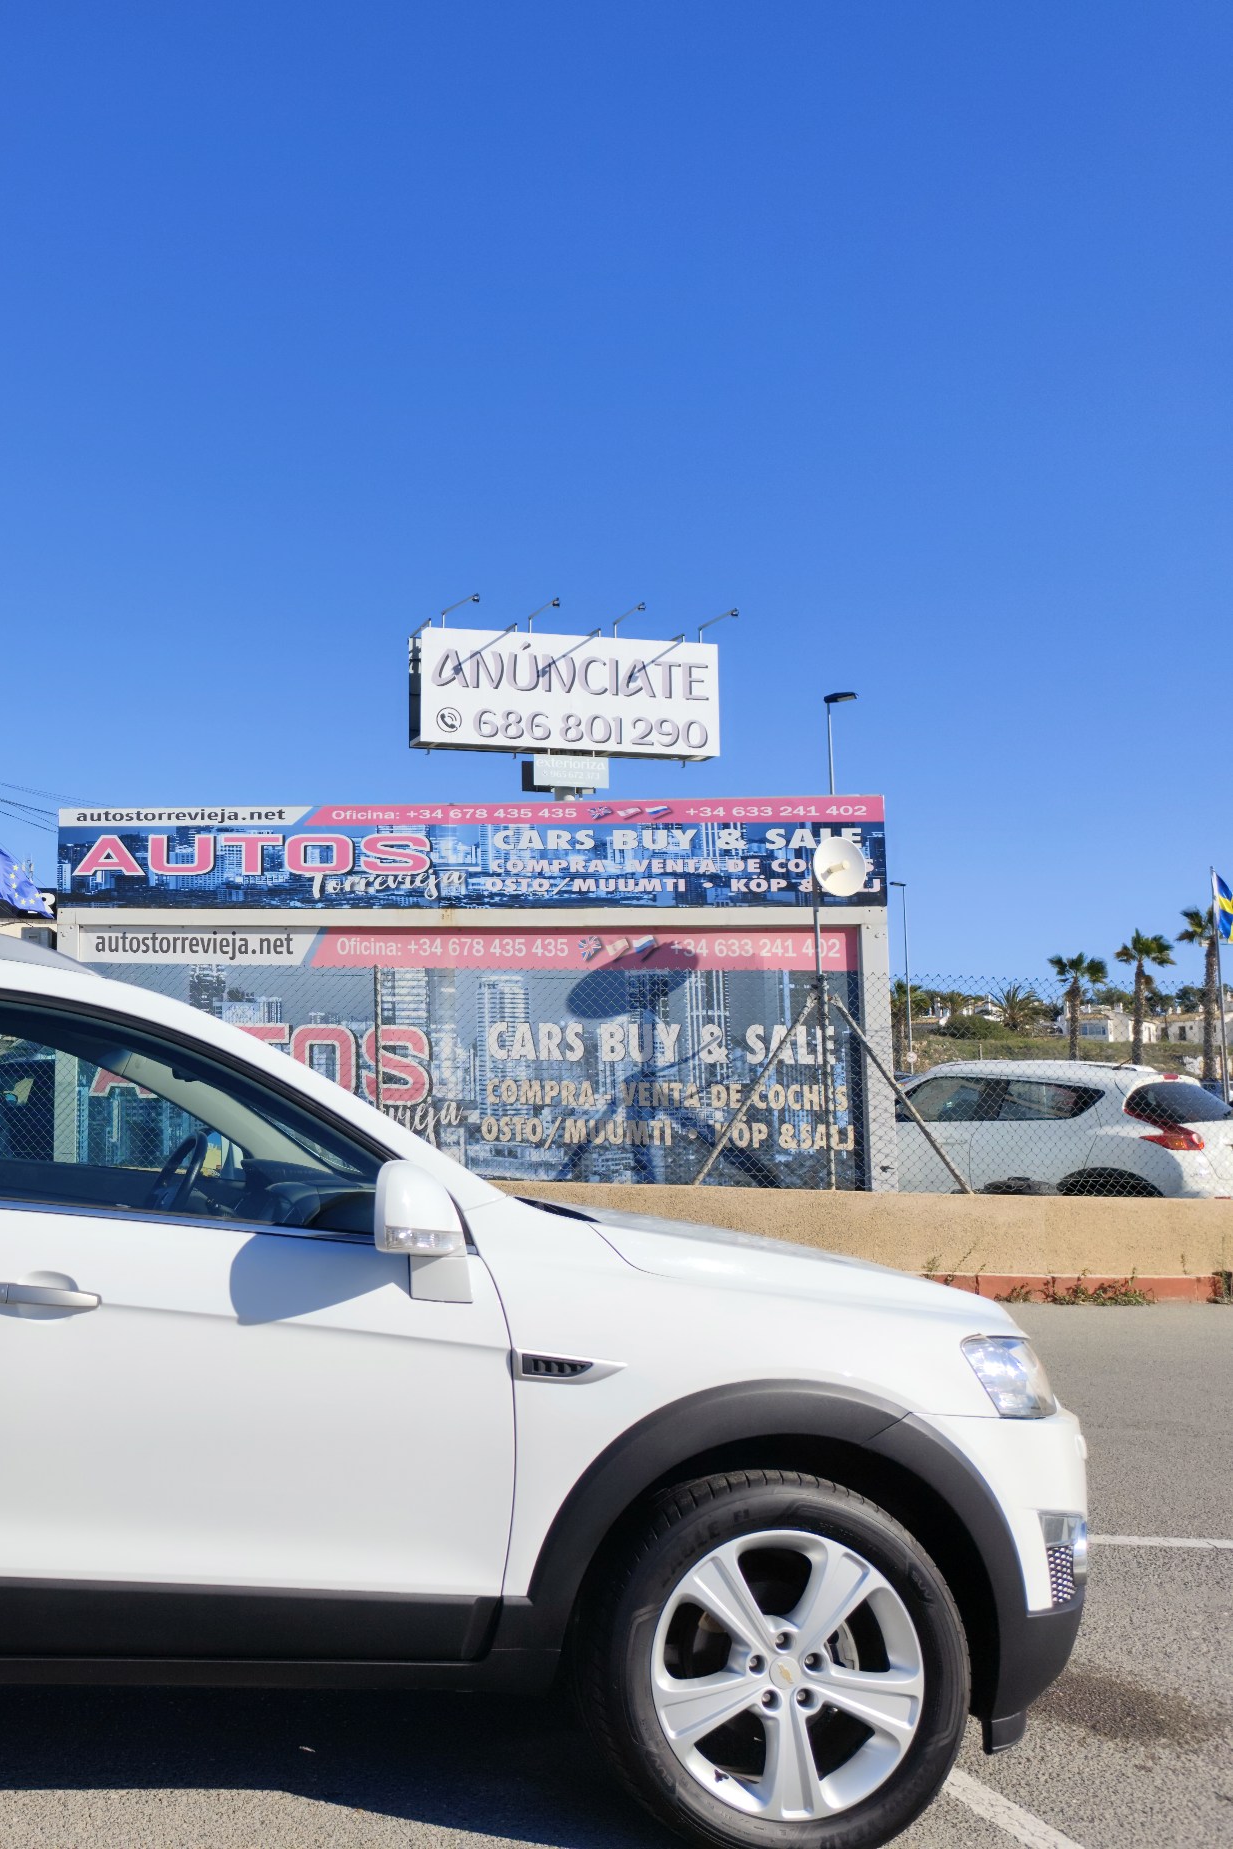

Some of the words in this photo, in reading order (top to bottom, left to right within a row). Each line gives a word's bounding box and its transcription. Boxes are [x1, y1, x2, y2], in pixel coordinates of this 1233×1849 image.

[431, 641, 709, 700] ANÚNCIATE
[473, 709, 551, 741] 686
[76, 808, 286, 823] autostorrevieja.net
[331, 809, 400, 820] Oficina:
[406, 809, 444, 819] +34
[449, 808, 488, 819] 678
[493, 808, 532, 818] 435
[537, 807, 577, 818] 435
[685, 806, 726, 817] +34
[732, 806, 773, 817] 633
[779, 806, 820, 816] 241
[825, 805, 867, 816] 402
[493, 829, 596, 851] CARS
[612, 829, 698, 851] BUY
[716, 828, 748, 850] &
[72, 833, 431, 876] AUTOS
[490, 859, 606, 873] COMPRA
[634, 858, 717, 873] VENTA
[727, 858, 761, 873] DE
[309, 867, 467, 900] Torrevieja
[730, 875, 788, 892] KÖP
[94, 930, 294, 961] autostorrevieja.net
[336, 937, 402, 956] Oficina:
[407, 938, 443, 957] +34
[448, 938, 485, 957] 678
[490, 938, 527, 957] 435
[531, 938, 569, 957] 435
[670, 938, 709, 957] +34
[714, 938, 753, 957] 633
[759, 938, 797, 957] 241
[488, 1021, 585, 1062] CARS
[600, 1022, 682, 1063] BUY
[698, 1023, 730, 1064] &
[486, 1079, 597, 1107] COMPRA
[621, 1081, 701, 1108] VENTA
[710, 1083, 742, 1109] DE
